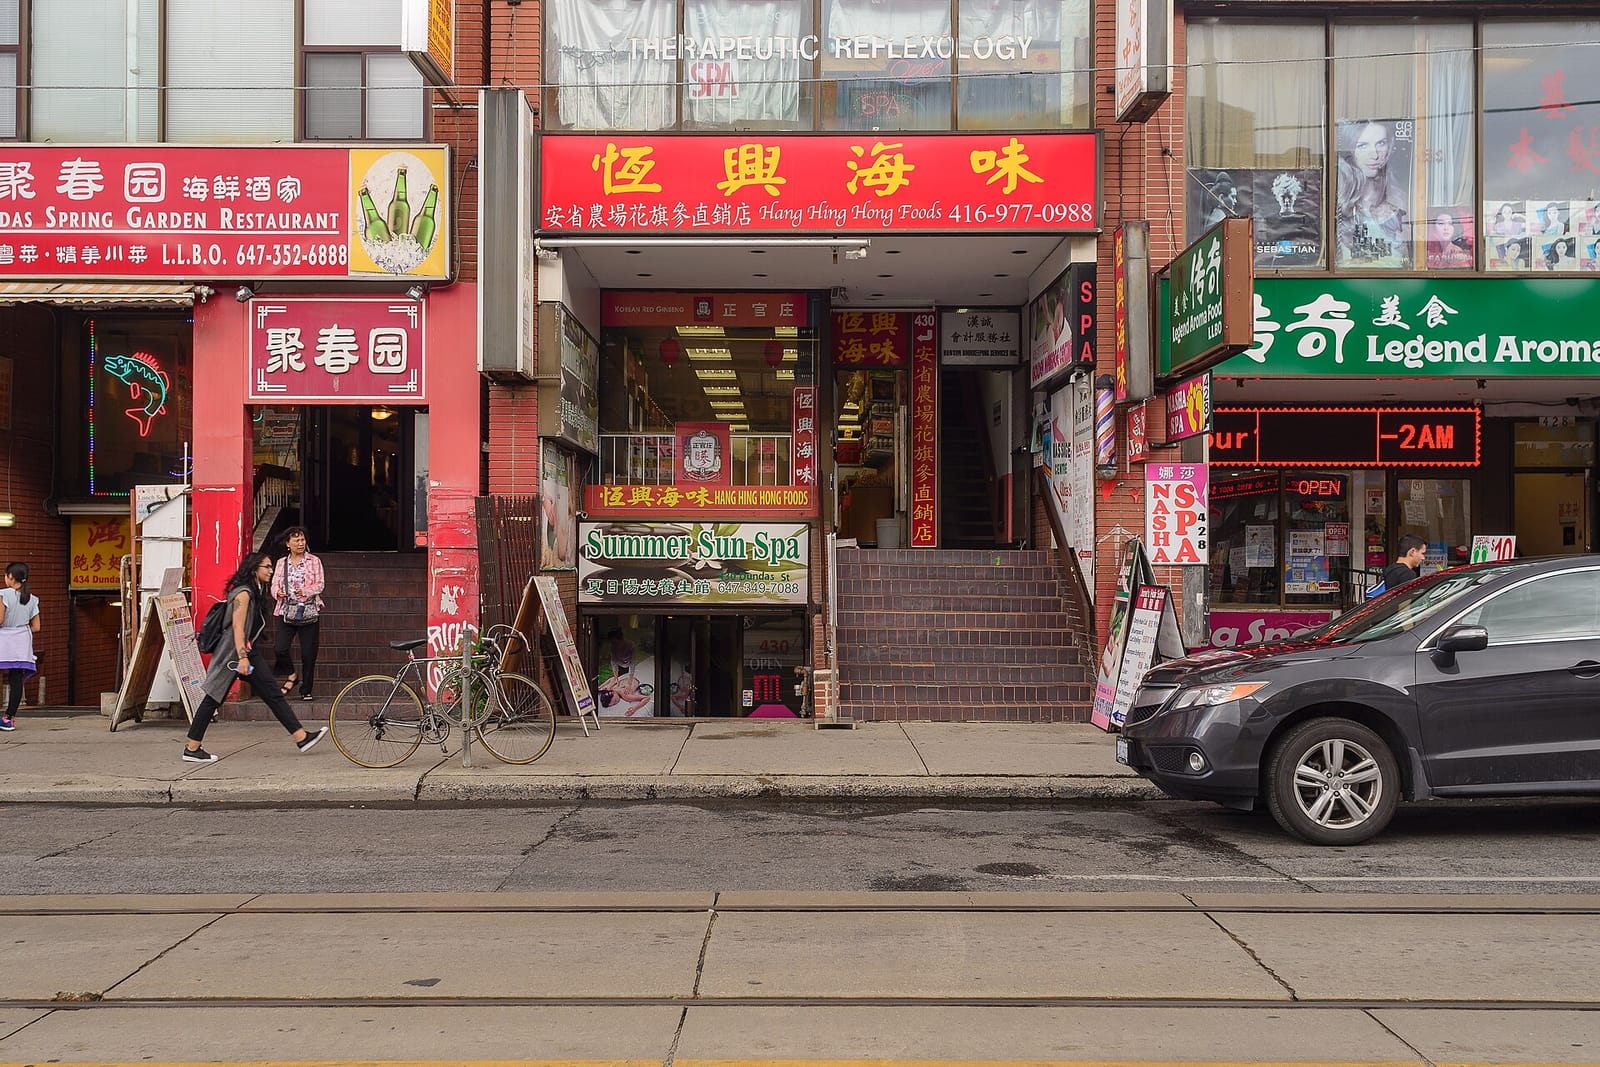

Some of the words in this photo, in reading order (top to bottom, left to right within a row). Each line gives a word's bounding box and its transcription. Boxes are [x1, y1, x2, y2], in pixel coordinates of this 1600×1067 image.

[627, 34, 819, 61] THERAPEUTIC
[835, 34, 1033, 61] REFLEXOLOGY
[690, 62, 738, 97] SPA
[861, 96, 901, 118] SPA
[592, 137, 1045, 197] 恆興海味
[0, 156, 166, 203] 聚春园
[45, 205, 113, 228] SPRING
[126, 206, 207, 229] GARDEN
[220, 207, 339, 229] RESTAURANT
[545, 202, 752, 229] 安省農場花旗參直銷店
[759, 200, 803, 226] Hang
[807, 200, 847, 227] Hing
[851, 200, 893, 227] Hong
[898, 202, 942, 220] Foods
[948, 203, 1093, 224] 416-977-0988
[162, 243, 227, 265] L.L.B.O.
[236, 243, 348, 266] 647-352-6888
[1256, 245, 1316, 254] SEBASTIAN
[722, 302, 794, 317] 正官庄
[914, 314, 935, 327] 430
[1080, 281, 1093, 362] SPA
[1172, 315, 1190, 344] Legend
[1189, 308, 1208, 333] Aroma
[1207, 296, 1222, 322] Food
[1372, 294, 1459, 331] 美食
[265, 323, 408, 374] 聚春园
[1366, 333, 1488, 369] Legend
[1170, 413, 1184, 436] SPA
[1542, 415, 1569, 428] 428
[796, 392, 814, 484] 恆興海味
[913, 346, 935, 542] 安省農場花旗參直銷店
[1158, 466, 1195, 480] 娜莎
[600, 486, 714, 508] 恆興海味
[714, 490, 736, 506] HANG
[738, 490, 757, 506] HING
[759, 490, 782, 506] HONG
[783, 490, 808, 506] FOODS
[1298, 480, 1341, 496] OPEN
[1152, 483, 1171, 562] NASHA
[1174, 483, 1200, 562] SPA
[1197, 512, 1207, 550] 428
[586, 530, 691, 560] Summer
[698, 530, 748, 560] Sun
[754, 530, 800, 567] Spa
[1490, 537, 1513, 560] $10
[73, 576, 90, 584] 434
[92, 575, 121, 584] Dunda
[587, 578, 710, 596] 夏日陽光養生館
[717, 582, 799, 595] 647-349-7088
[739, 571, 775, 582] Dundas
[780, 572, 791, 582] St
[759, 639, 790, 653] 430
[750, 656, 783, 671] OPEN
